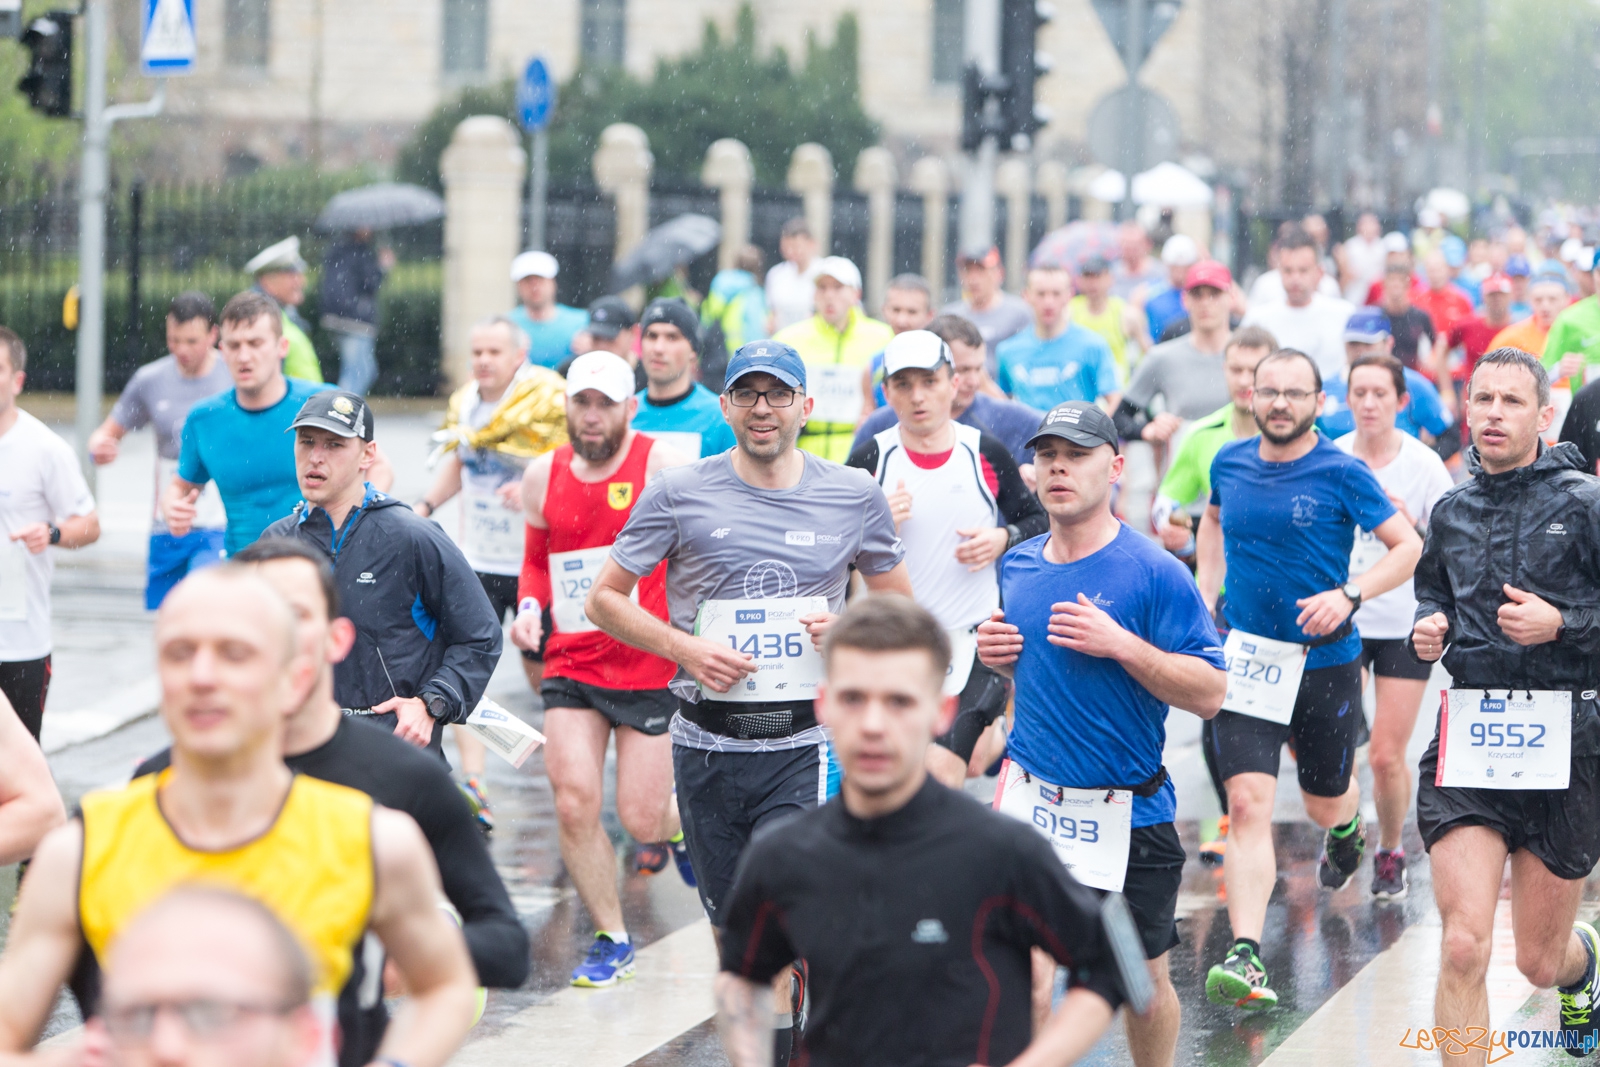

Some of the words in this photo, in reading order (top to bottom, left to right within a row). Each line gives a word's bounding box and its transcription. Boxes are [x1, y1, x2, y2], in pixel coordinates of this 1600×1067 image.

[728, 633, 803, 659] 1436
[755, 663, 784, 671] ominik
[1470, 722, 1546, 748] 9552
[1488, 751, 1524, 759] Krzysztof
[1033, 805, 1099, 843] 6193
